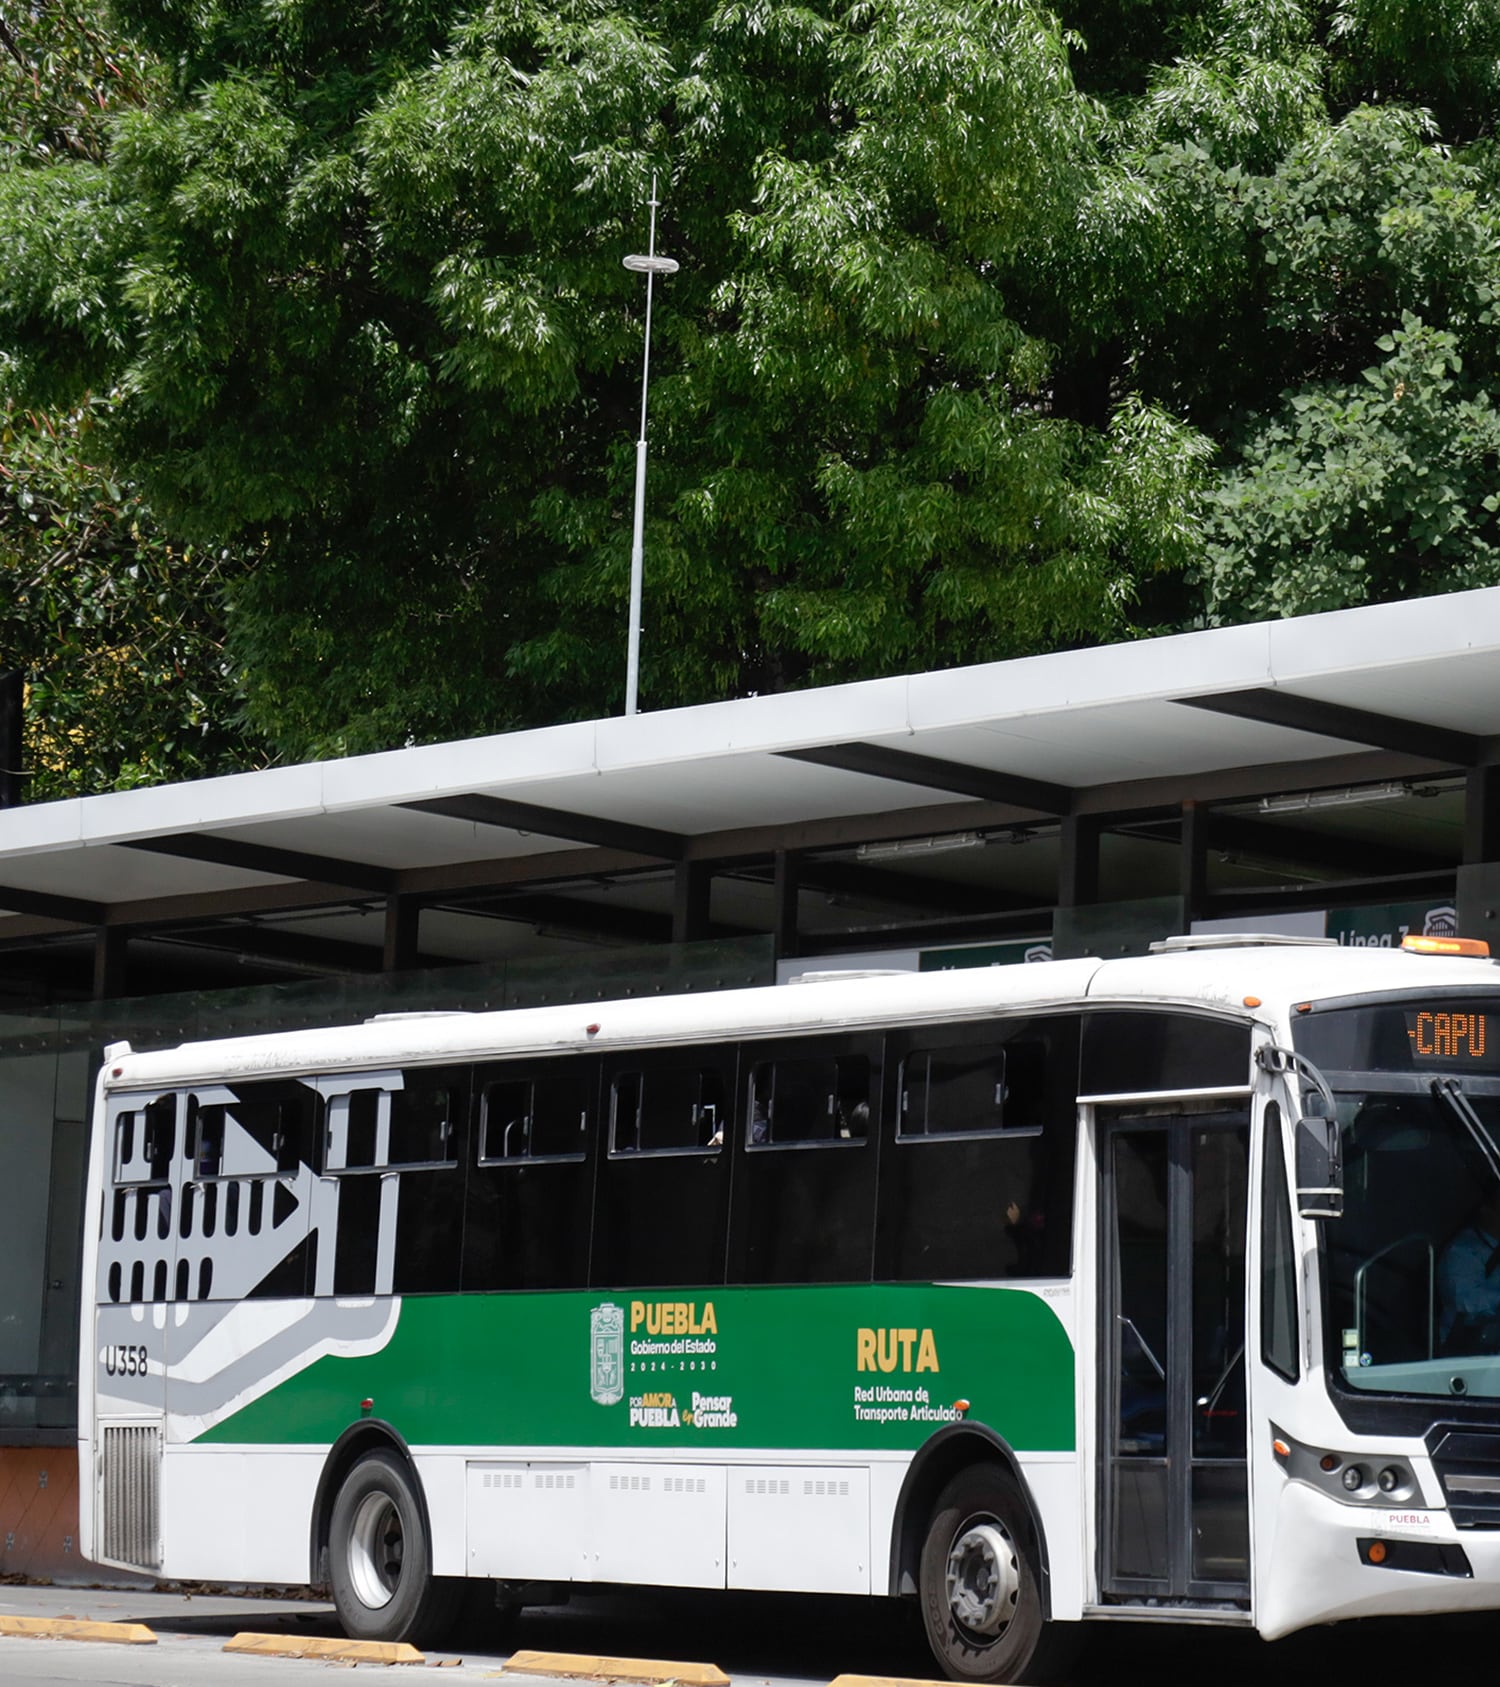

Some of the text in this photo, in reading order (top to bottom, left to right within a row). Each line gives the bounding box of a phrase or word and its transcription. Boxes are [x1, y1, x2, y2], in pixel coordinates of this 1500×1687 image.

[630, 1300, 718, 1335] PUEBLA
[630, 1338, 717, 1355] Gobierno del Estado
[857, 1328, 940, 1373] RUTA
[106, 1345, 148, 1377] U358
[642, 1393, 672, 1408] AMOR
[691, 1391, 732, 1411] Pensar
[854, 1386, 875, 1402] Red
[875, 1386, 913, 1402] Urbana
[629, 1408, 680, 1428] PUEBLA
[693, 1409, 738, 1429] Grande
[853, 1404, 963, 1424] Transporte Articulado
[1389, 1514, 1430, 1525] PUEBLA
